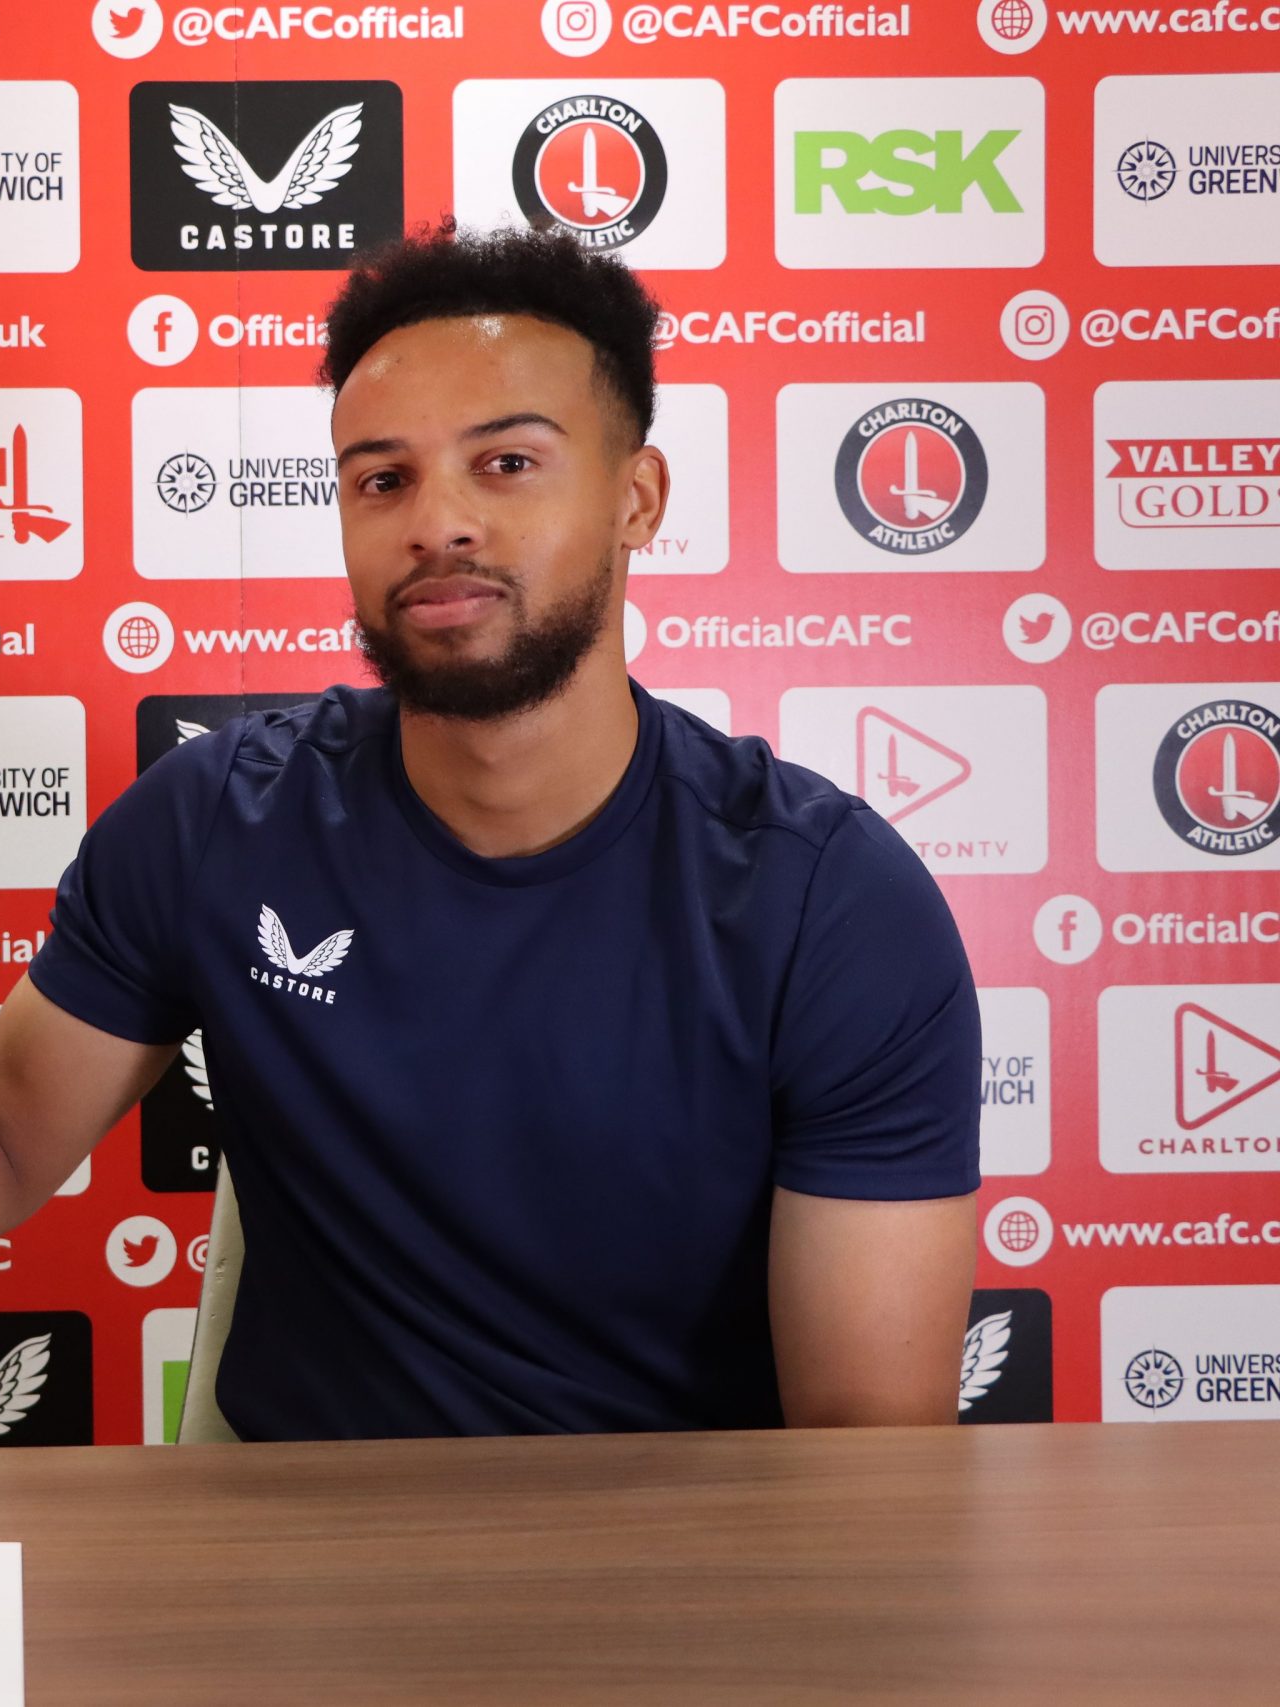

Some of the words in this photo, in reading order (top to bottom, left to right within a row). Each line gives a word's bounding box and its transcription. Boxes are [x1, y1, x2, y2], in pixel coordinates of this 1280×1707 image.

[173, 4, 464, 47] @CAFCofficial
[623, 3, 910, 45] @CAFCofficial
[536, 98, 642, 134] CHARLTON
[35, 152, 62, 172] OF
[794, 129, 1024, 216] RSK
[1189, 169, 1280, 194] GREEN
[180, 223, 355, 250] CASTORE
[858, 402, 963, 437] CHARLTON
[1128, 445, 1280, 473] VALLEY
[1135, 485, 1269, 518] GOLD
[869, 523, 955, 551] ATHLETIC
[657, 615, 911, 648] OfficialCAFC
[1176, 704, 1280, 739] CHARLTON
[40, 767, 69, 788] OF
[1187, 823, 1273, 850] ATHLETIC
[250, 966, 336, 1004] CASTORE
[1007, 1057, 1033, 1077] OF
[1139, 1137, 1280, 1154] CHARLTO
